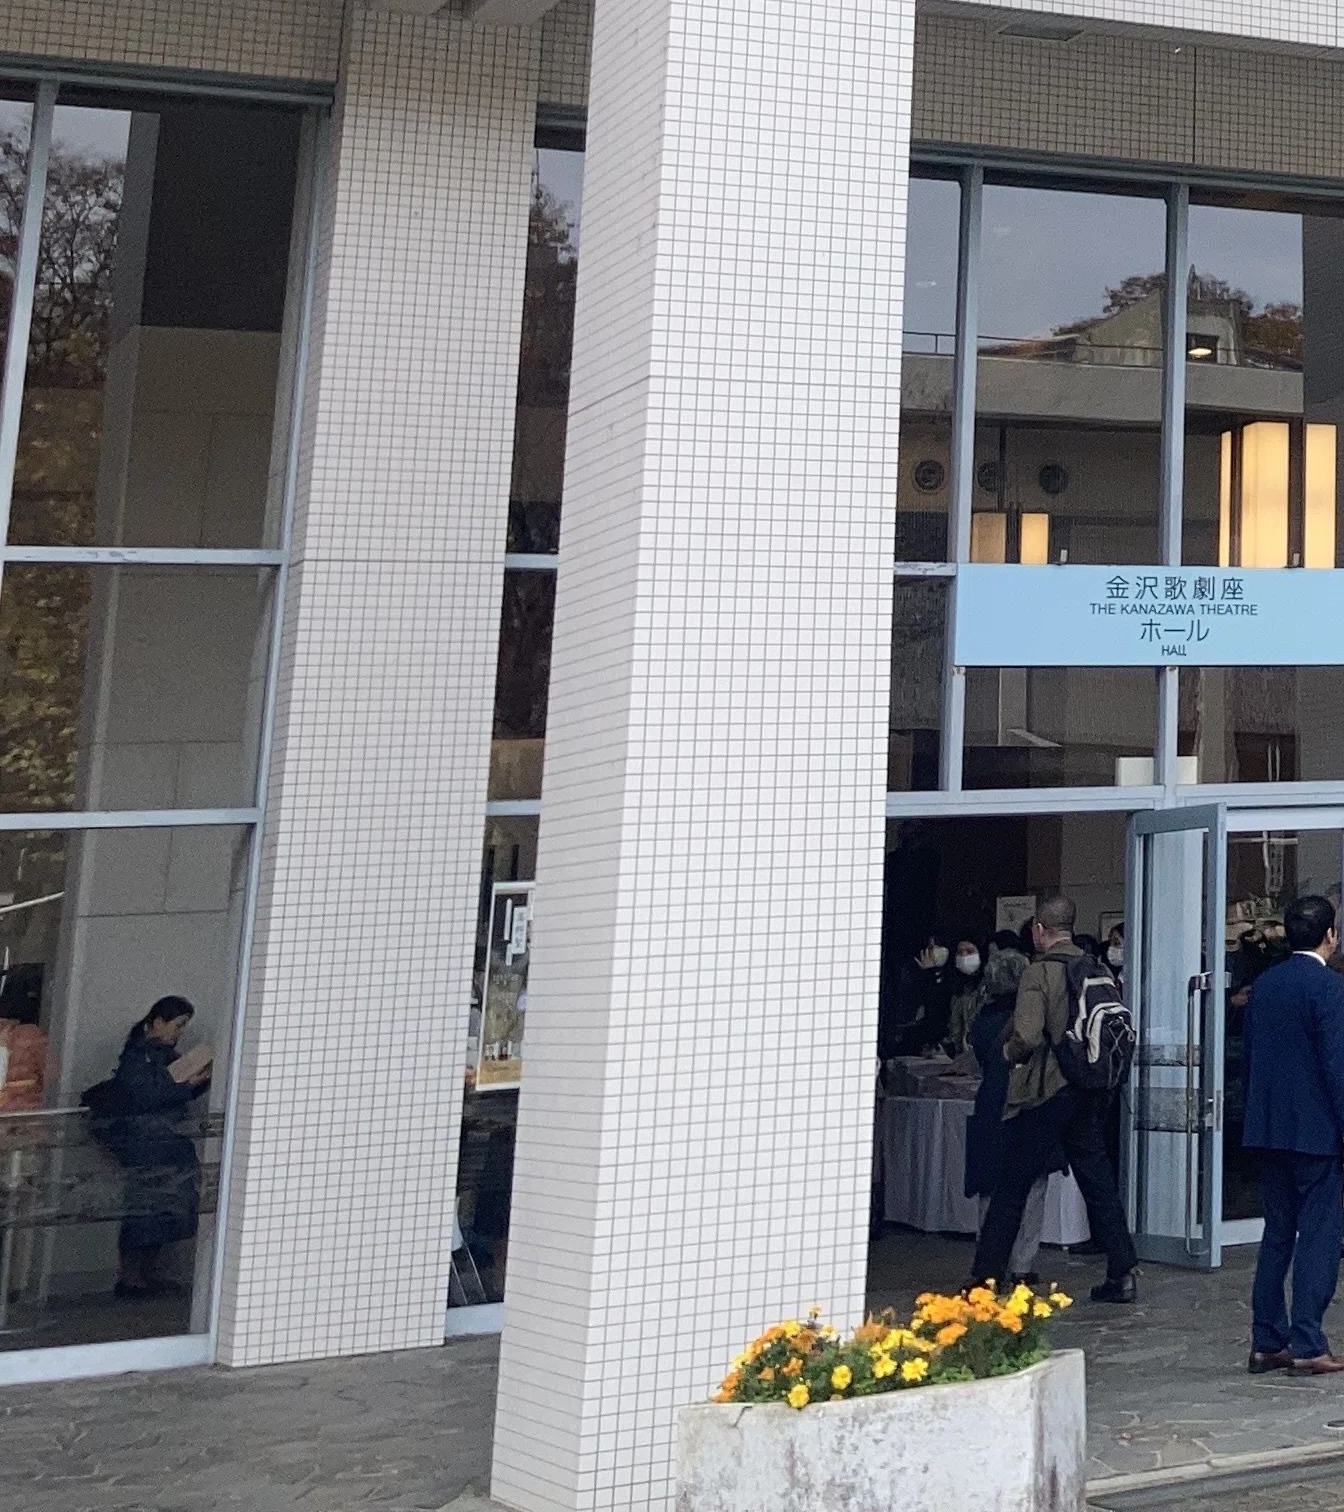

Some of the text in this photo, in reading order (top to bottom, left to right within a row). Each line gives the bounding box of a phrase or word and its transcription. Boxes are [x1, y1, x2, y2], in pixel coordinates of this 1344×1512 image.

[1105, 575, 1245, 601] 金沢歌劇座
[1089, 602, 1259, 616] THE KANAZAWA THEATRE
[1140, 618, 1210, 642] ホール
[1161, 644, 1188, 657] HALL
